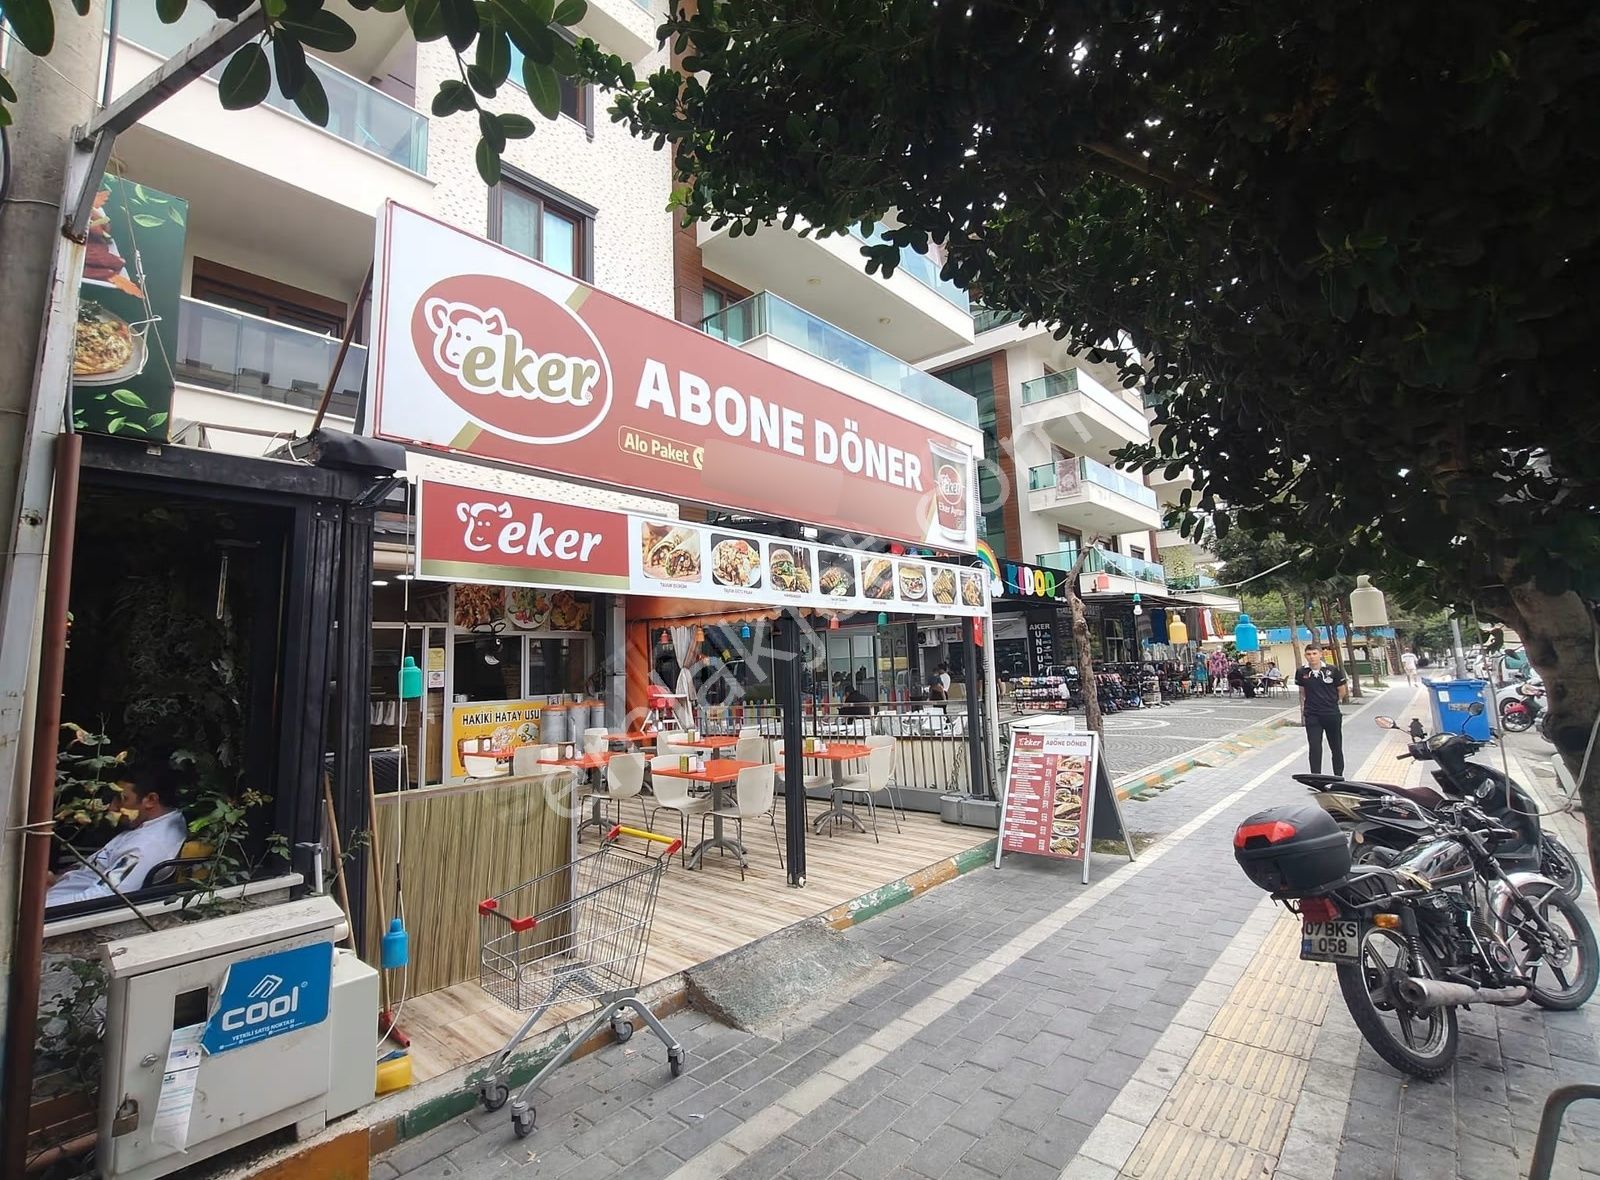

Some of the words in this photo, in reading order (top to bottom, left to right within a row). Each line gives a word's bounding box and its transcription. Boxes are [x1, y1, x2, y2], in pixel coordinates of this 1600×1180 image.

[462, 334, 595, 401] eker
[635, 357, 805, 457] ABONE
[815, 417, 923, 492] DÖNER
[624, 432, 648, 453] Alo
[651, 440, 690, 464] Paket
[498, 512, 602, 562] eker
[462, 710, 493, 726] HAKİKİ
[495, 710, 522, 722] HATAY
[1305, 921, 1322, 936] 07
[1325, 922, 1357, 938] BKS
[1319, 937, 1347, 954] 058
[222, 986, 299, 1031] cool
